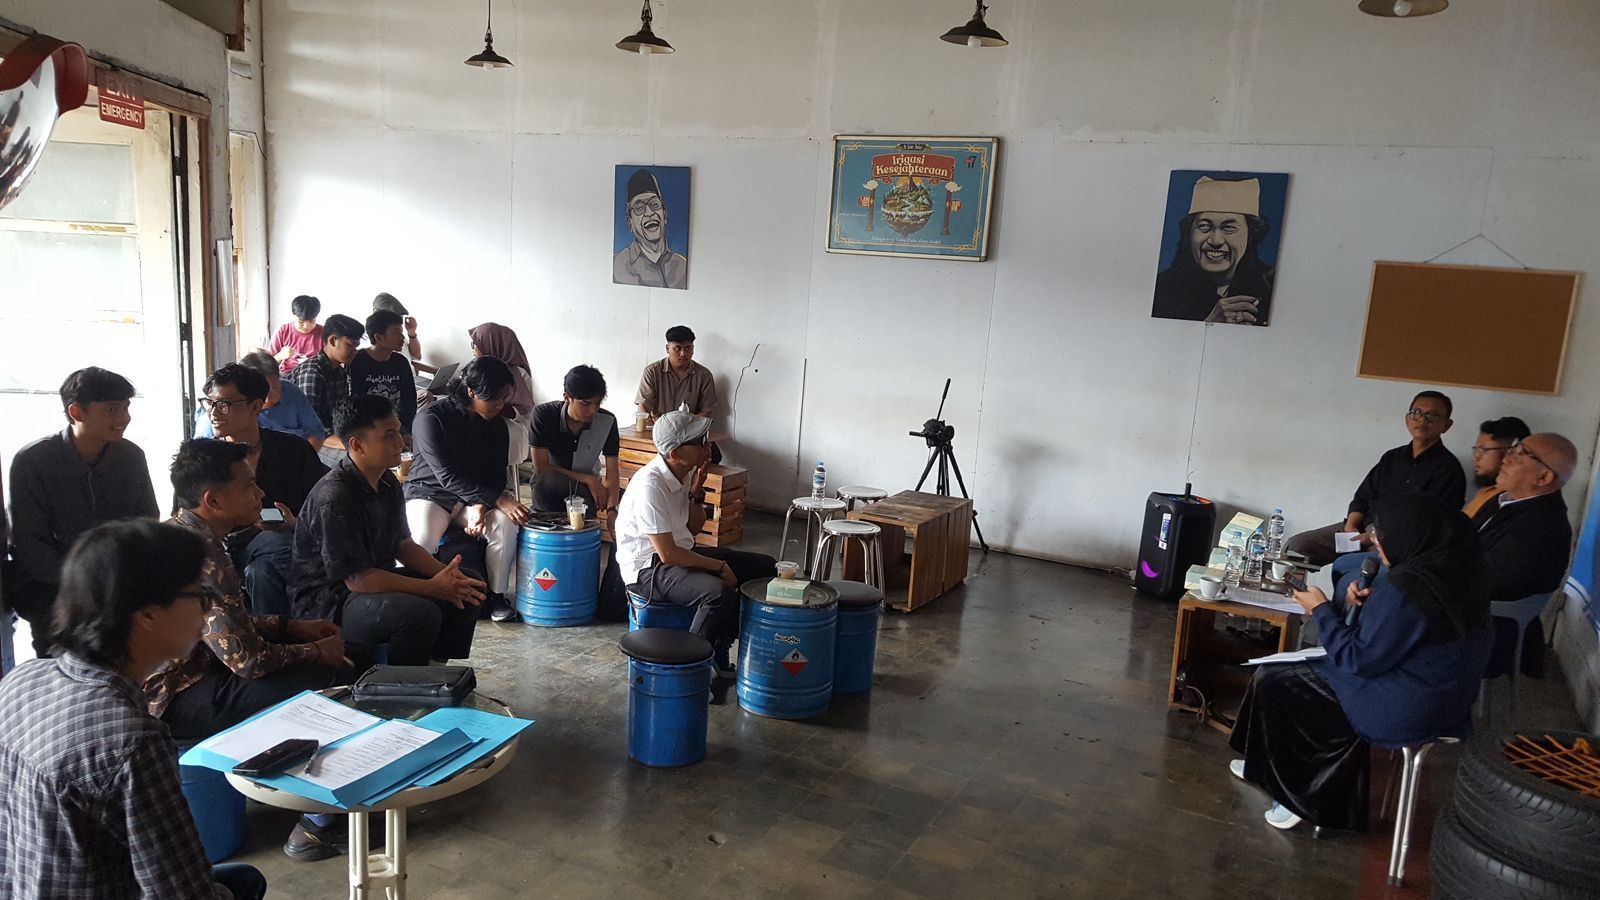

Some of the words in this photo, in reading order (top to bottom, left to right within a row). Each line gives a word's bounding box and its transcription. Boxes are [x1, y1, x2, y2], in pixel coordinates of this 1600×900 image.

[101, 102, 143, 123] EMERGENCY
[892, 154, 926, 166] Irigasi
[876, 163, 948, 177] Kesejahteraan
